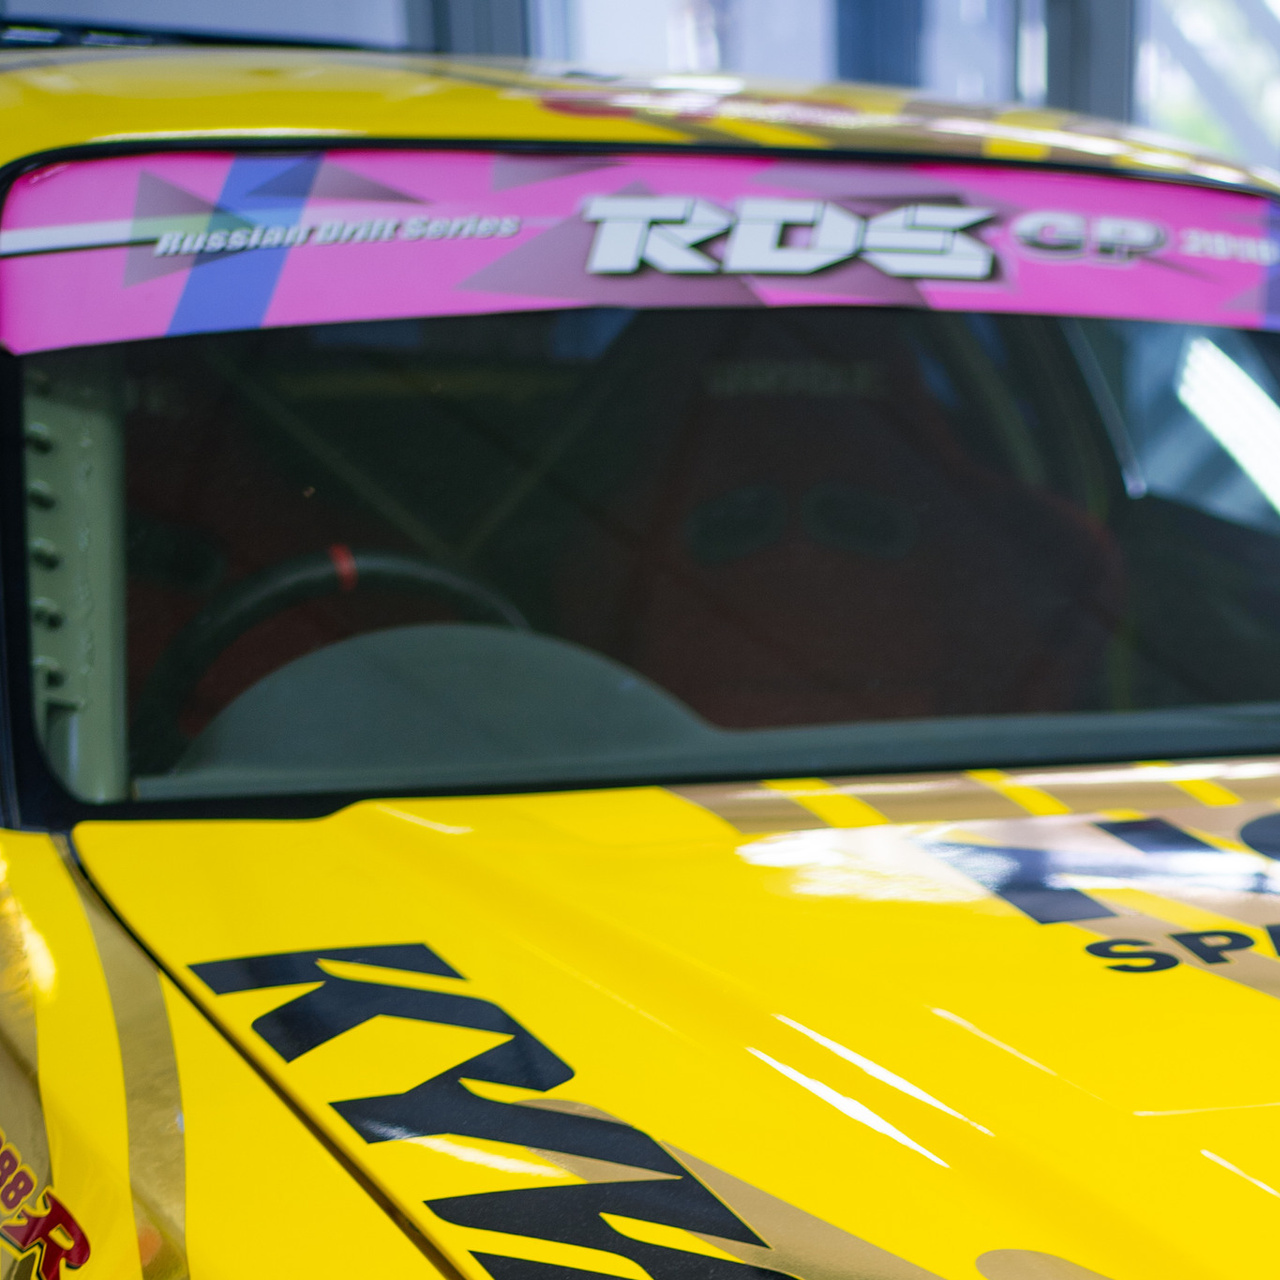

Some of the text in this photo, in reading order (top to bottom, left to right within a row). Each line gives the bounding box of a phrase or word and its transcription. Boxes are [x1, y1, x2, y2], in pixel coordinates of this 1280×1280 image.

[152, 213, 522, 258] Russian Drift Series
[582, 195, 1000, 279] RDS
[1011, 209, 1168, 264] GP
